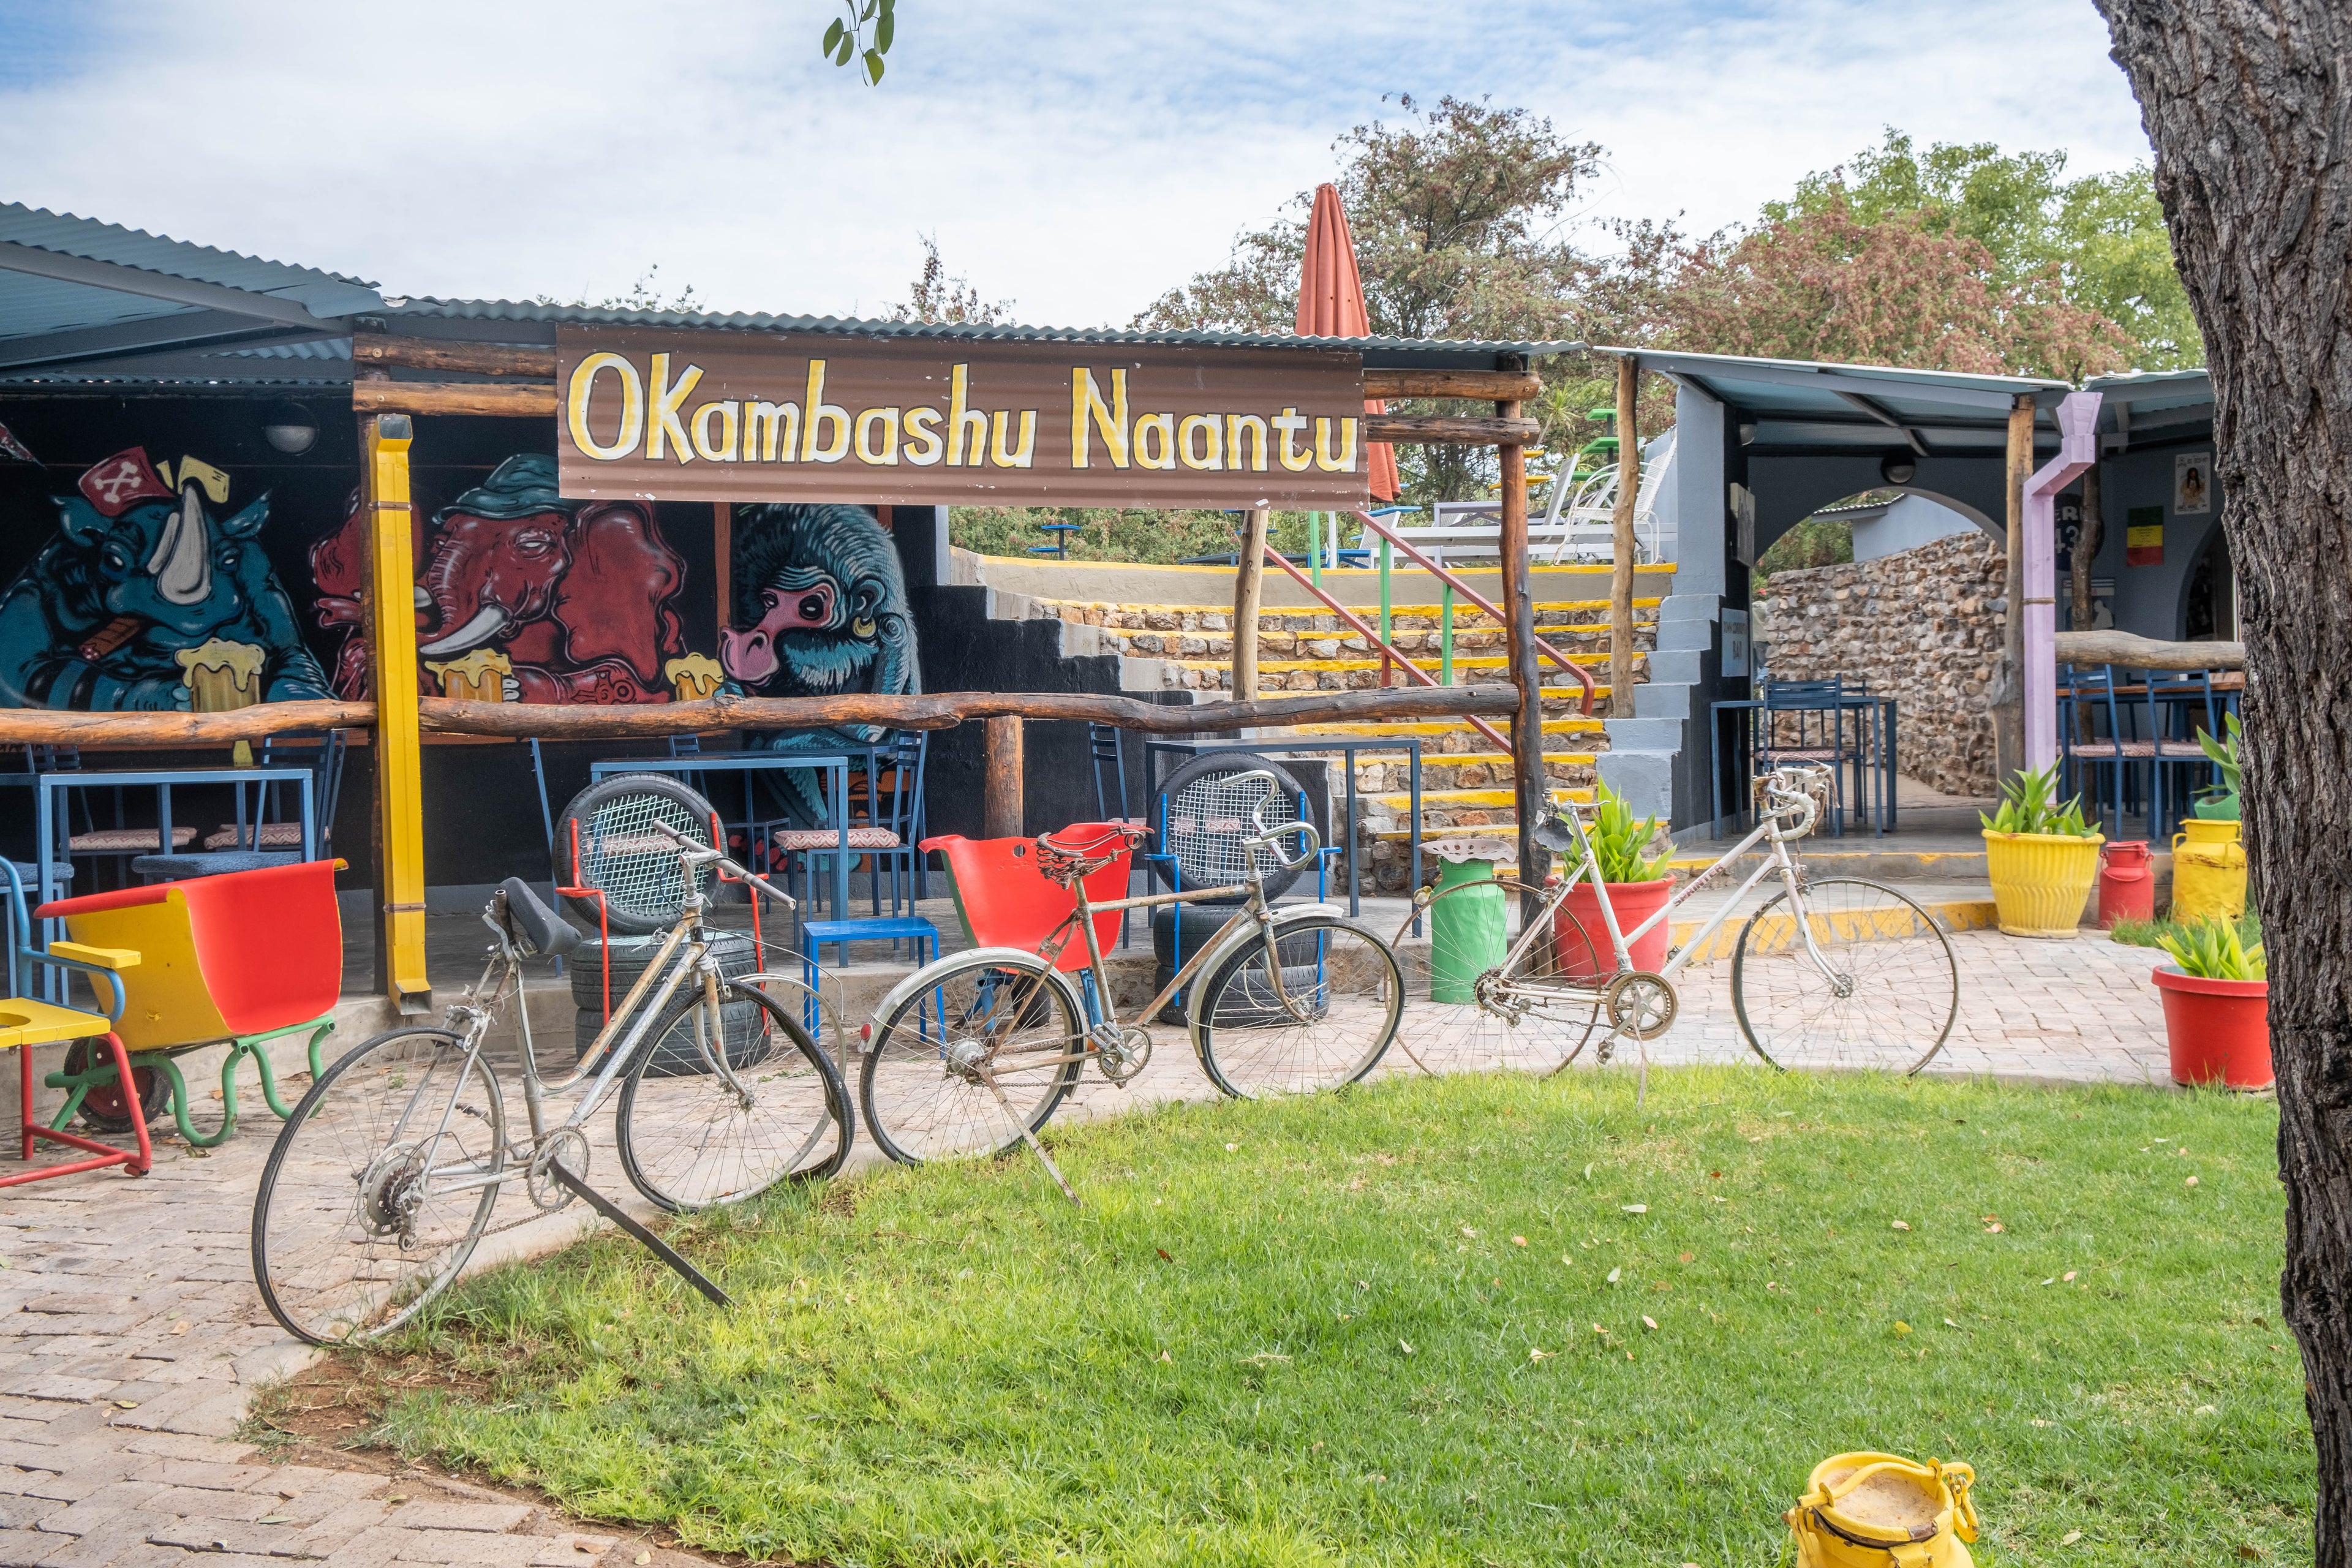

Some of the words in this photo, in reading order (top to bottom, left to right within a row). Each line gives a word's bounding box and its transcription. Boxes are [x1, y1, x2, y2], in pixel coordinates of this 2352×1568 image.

[567, 351, 1039, 469] OKambashu
[1070, 366, 1360, 473] Naantu
[1673, 864, 1724, 907] SPRINTER
